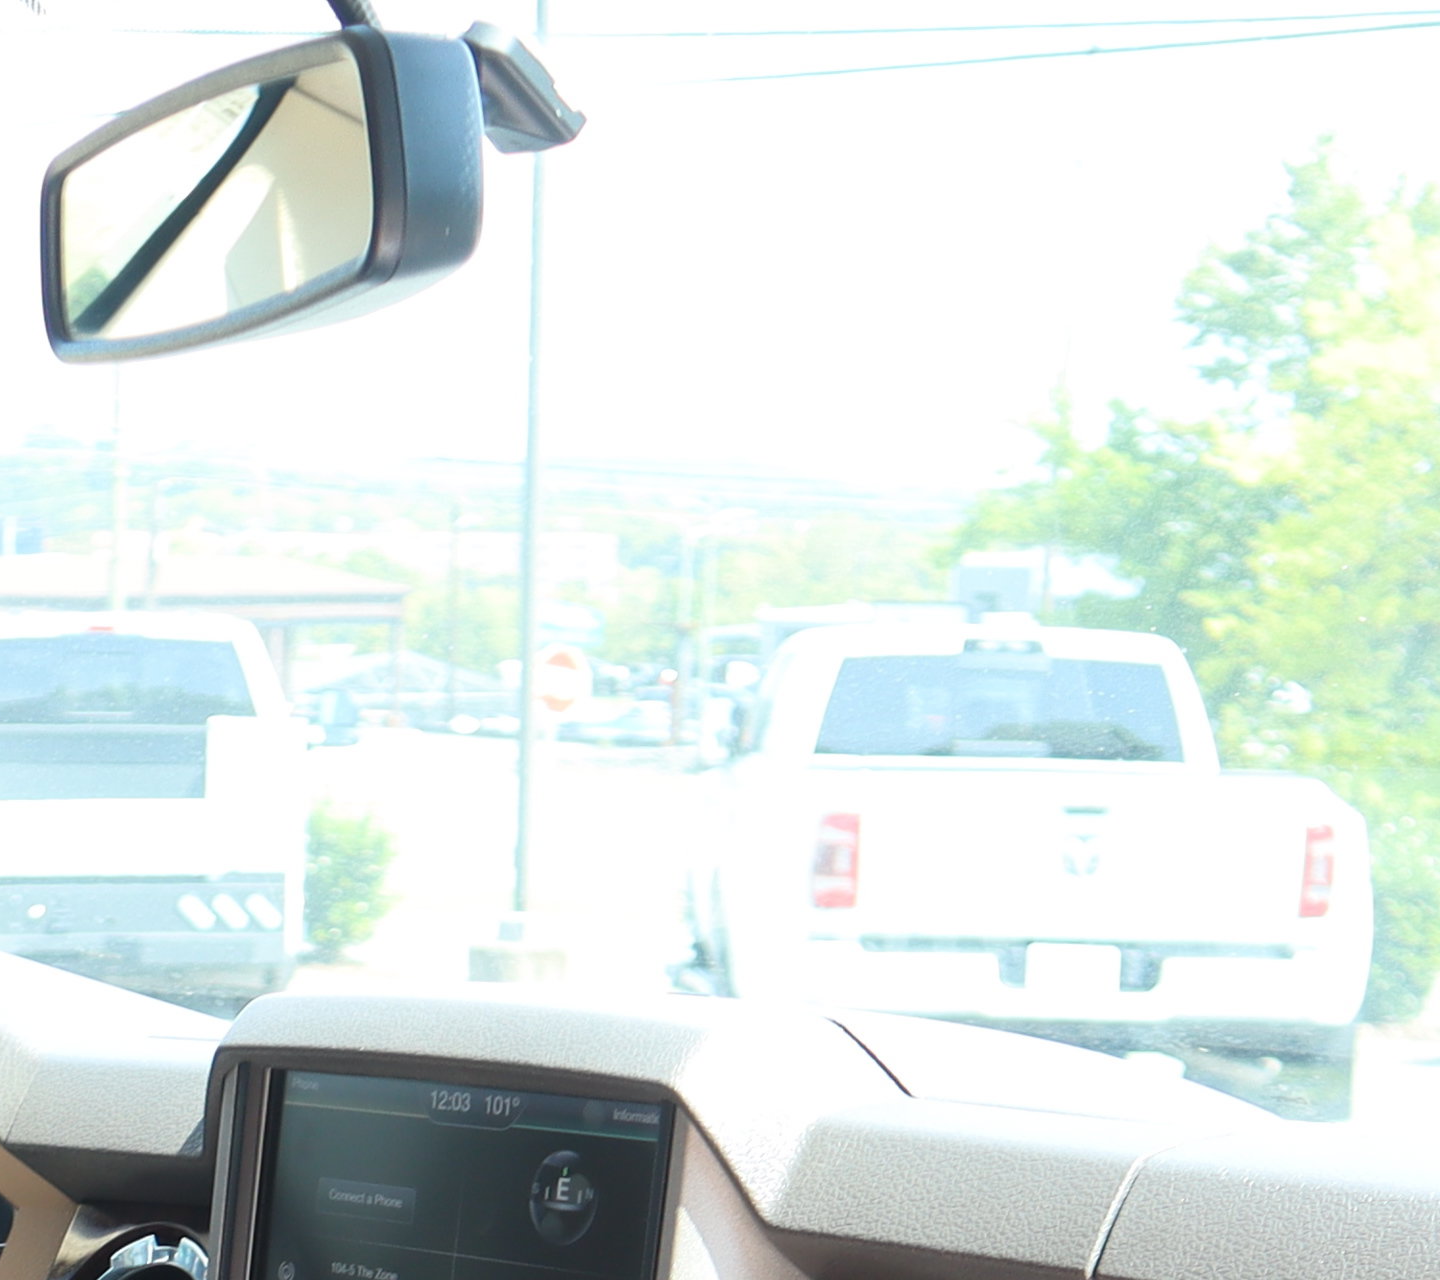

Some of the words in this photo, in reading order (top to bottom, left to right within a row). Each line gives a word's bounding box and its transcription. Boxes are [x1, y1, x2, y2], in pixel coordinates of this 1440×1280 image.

[430, 1089, 471, 1112] 12:03
[328, 1187, 365, 1204] Connect
[374, 1193, 403, 1209] Phone
[556, 1176, 571, 1201] E
[357, 1265, 373, 1279] The
